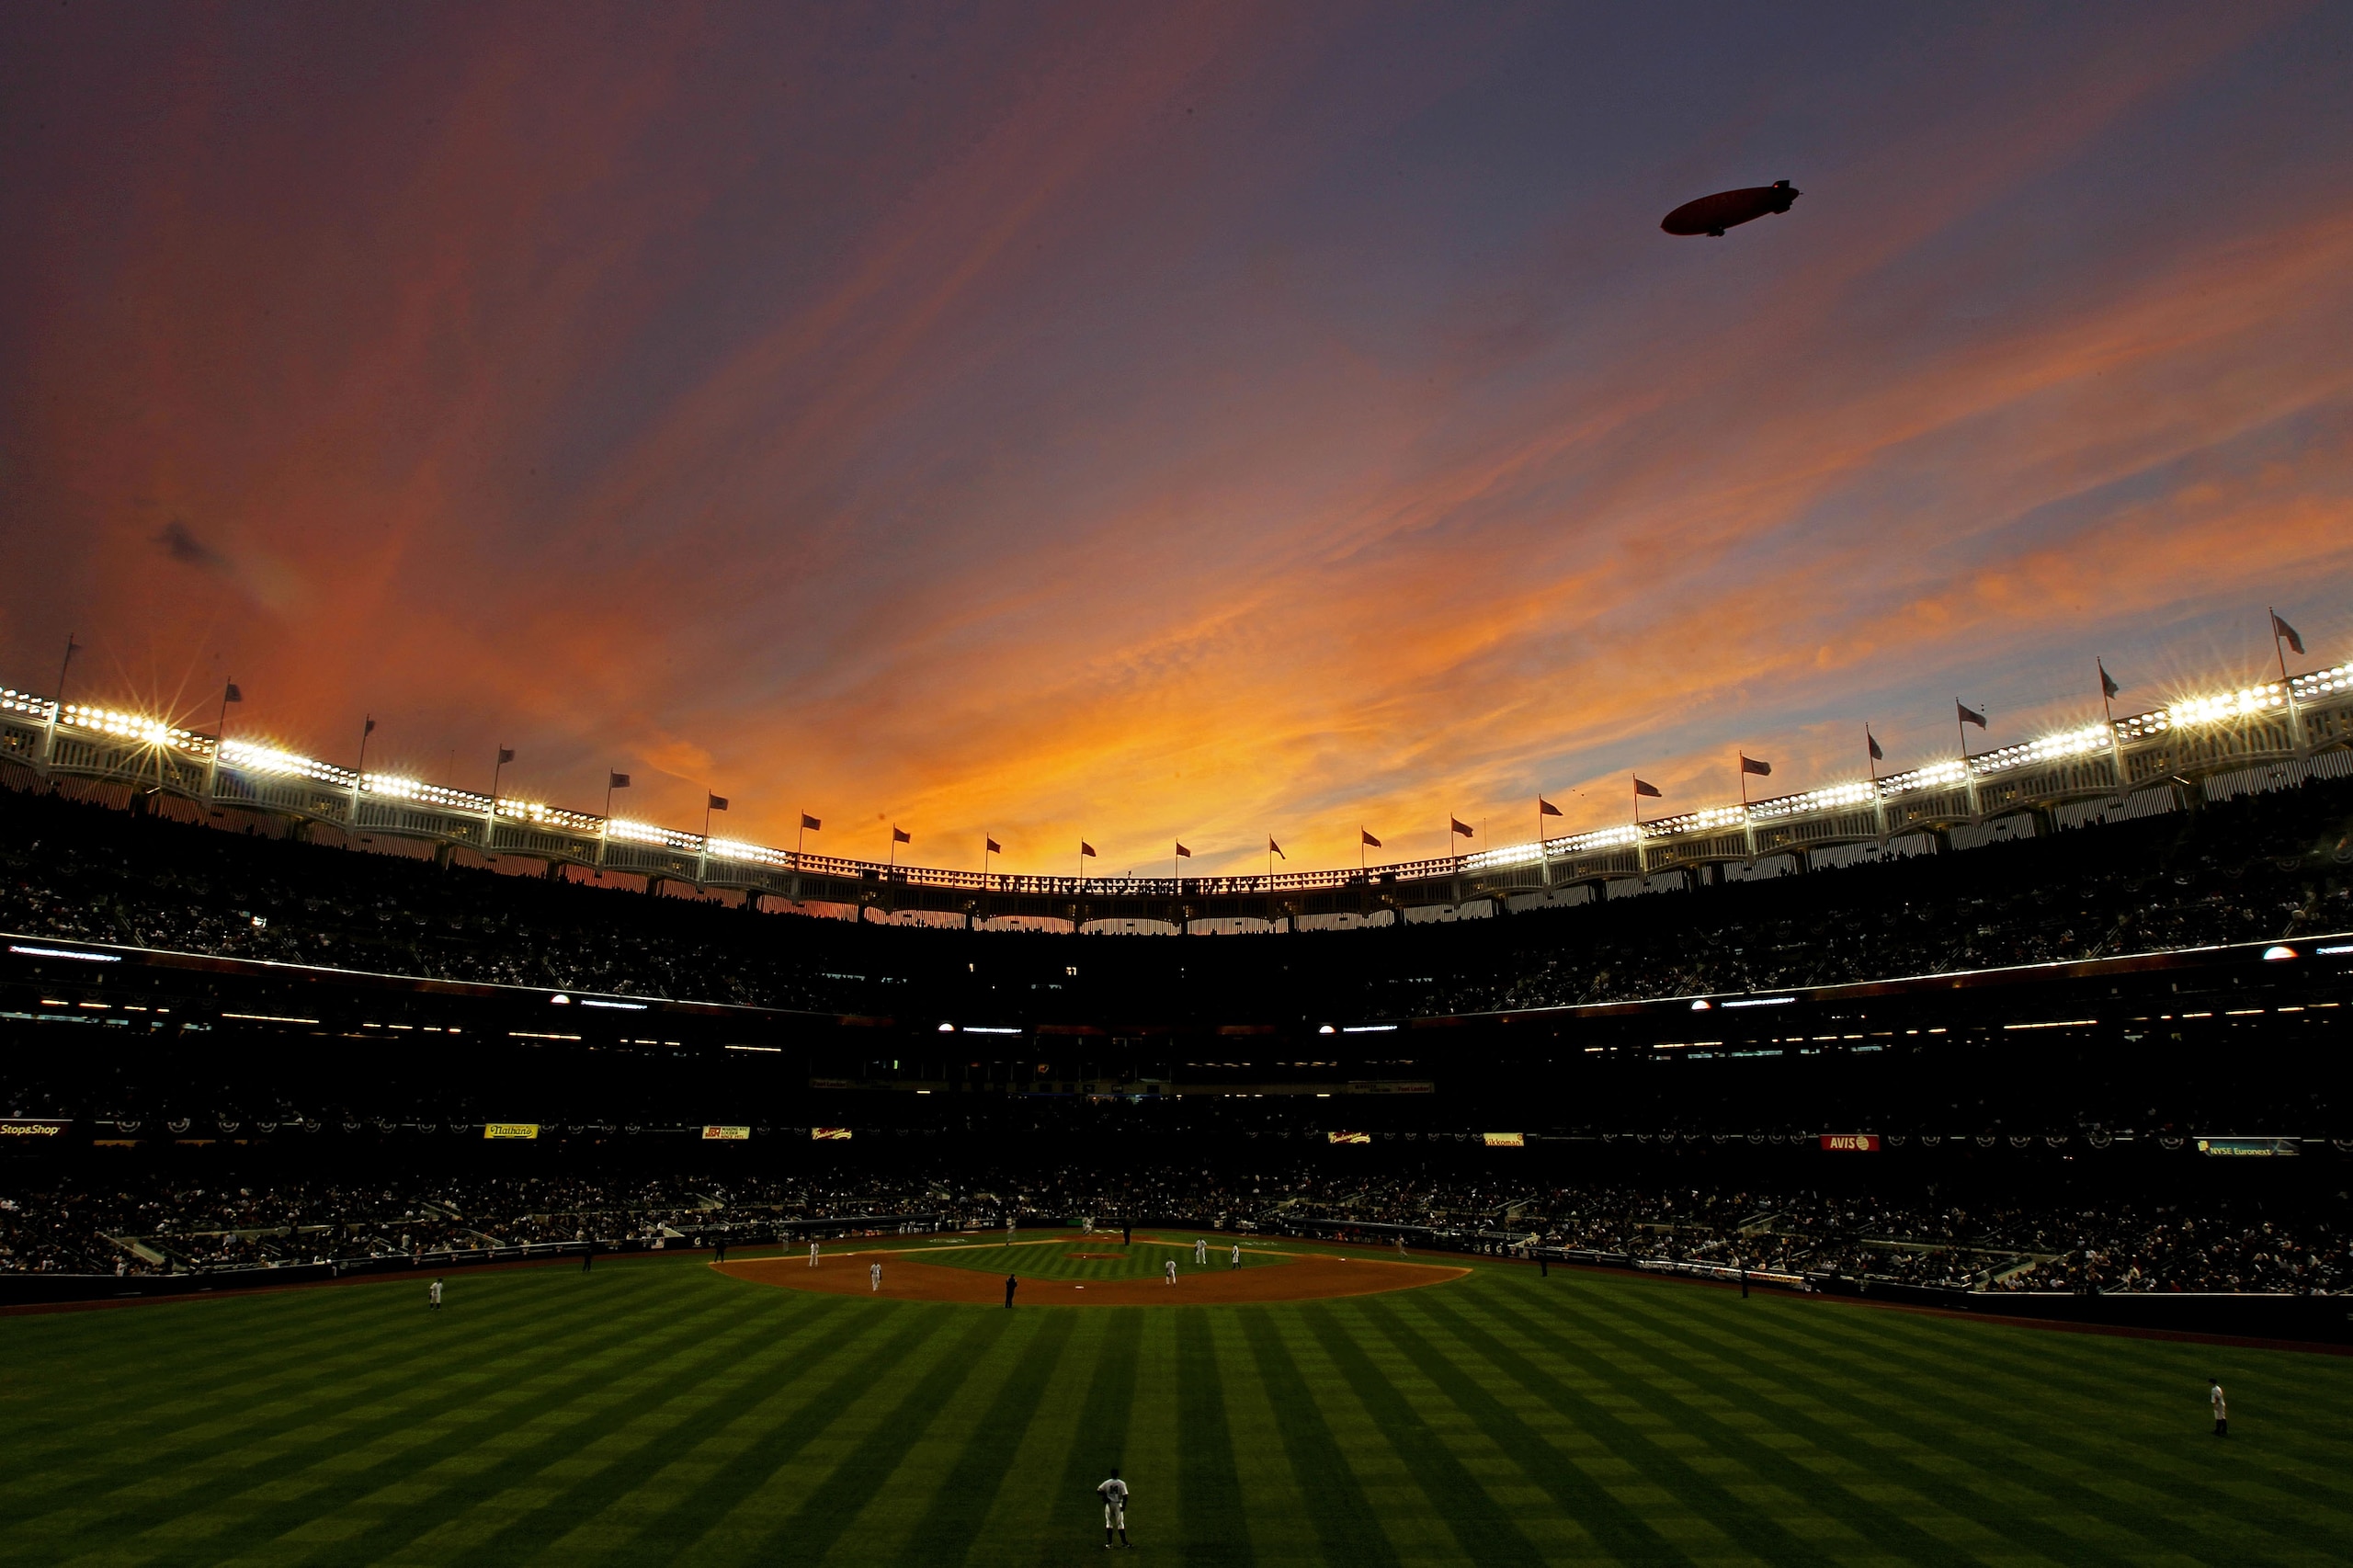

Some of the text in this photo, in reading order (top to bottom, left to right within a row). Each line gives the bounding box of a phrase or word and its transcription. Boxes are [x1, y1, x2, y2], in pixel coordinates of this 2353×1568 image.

[0, 1124, 59, 1136] Stop&Shop
[490, 1126, 532, 1135] Nathan's
[1830, 1137, 1856, 1149] AVIS
